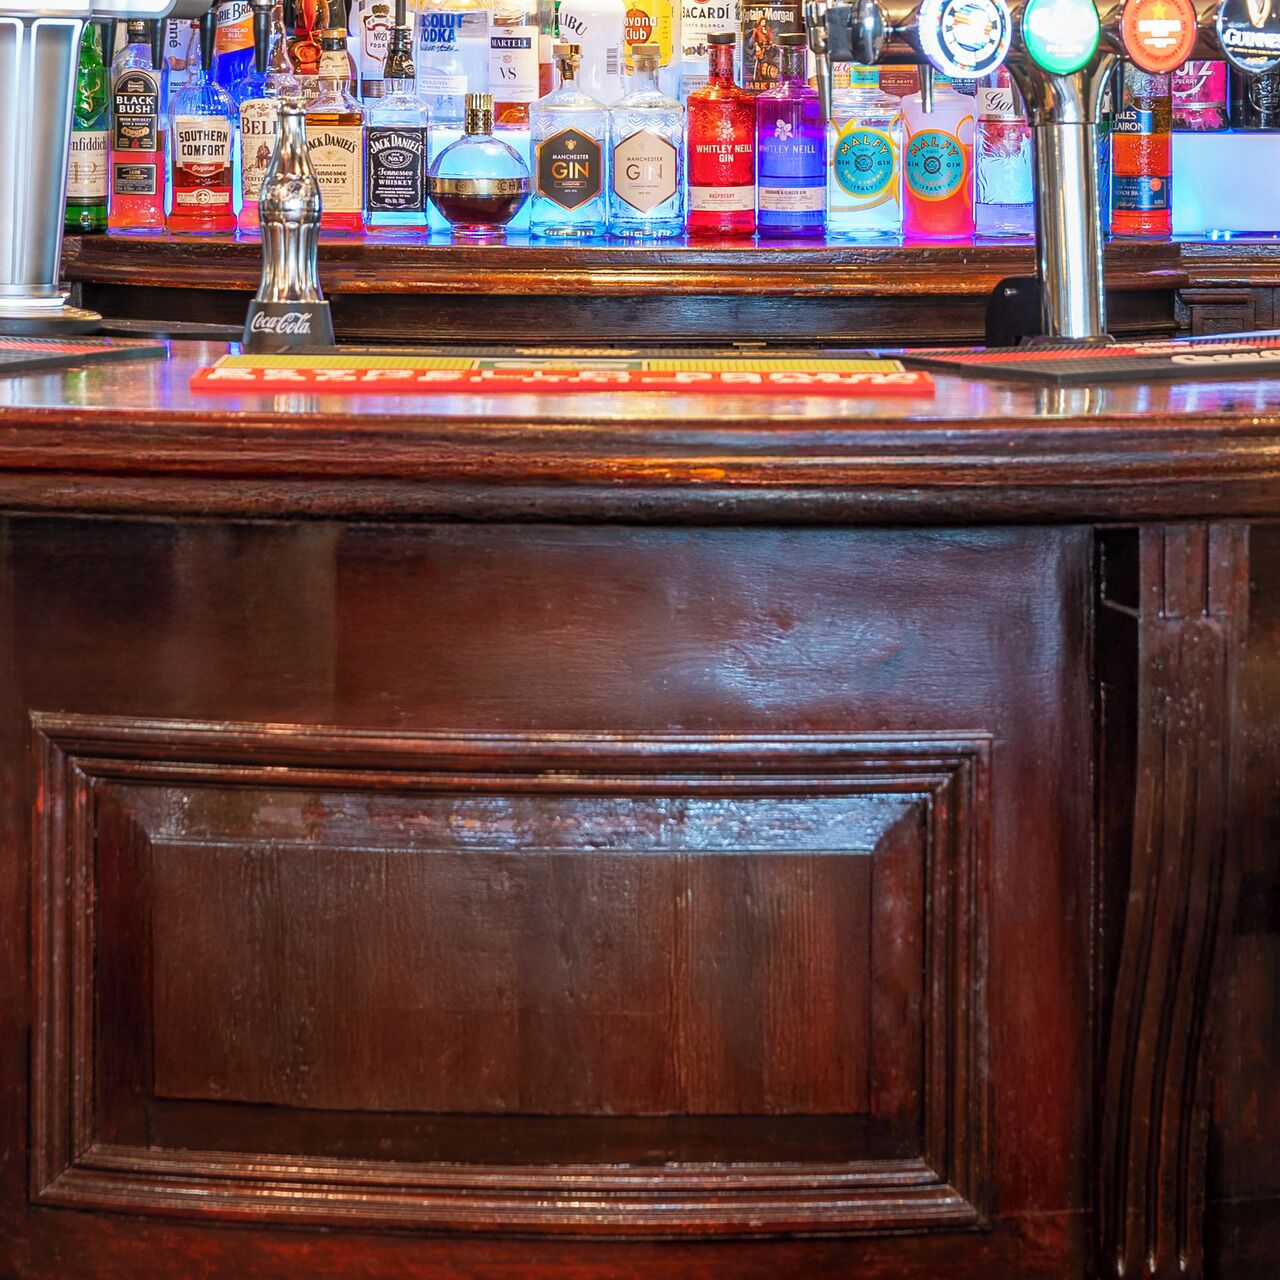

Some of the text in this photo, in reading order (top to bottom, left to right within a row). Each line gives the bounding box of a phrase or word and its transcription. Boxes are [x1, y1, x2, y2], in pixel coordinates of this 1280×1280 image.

[218, 9, 232, 21] RIE
[422, 14, 465, 28] BSOLUT
[625, 15, 657, 27] avana
[559, 13, 588, 36] LIBU
[491, 38, 530, 48] MARTELL
[500, 67, 517, 80] VS
[116, 96, 154, 105] BLACK
[119, 105, 151, 114] BUSH
[1112, 122, 1145, 131] LAIRON
[71, 132, 107, 151] nfiddich
[179, 130, 228, 142] SOUTHERN
[325, 133, 357, 153] DANIEL'S
[371, 133, 424, 154] JACK DANIEL'S
[696, 145, 752, 153] WHITLEY NEILL
[792, 145, 816, 153] NEILL
[840, 135, 890, 155] MALFY
[910, 136, 959, 157] MALFY
[181, 144, 226, 156] COMFORT
[719, 154, 734, 162] GIN
[192, 163, 216, 173] Original
[377, 168, 413, 176] Tennessee
[552, 162, 589, 178] GIN
[626, 164, 663, 179] GIN
[250, 311, 313, 335] Coca-Cola
